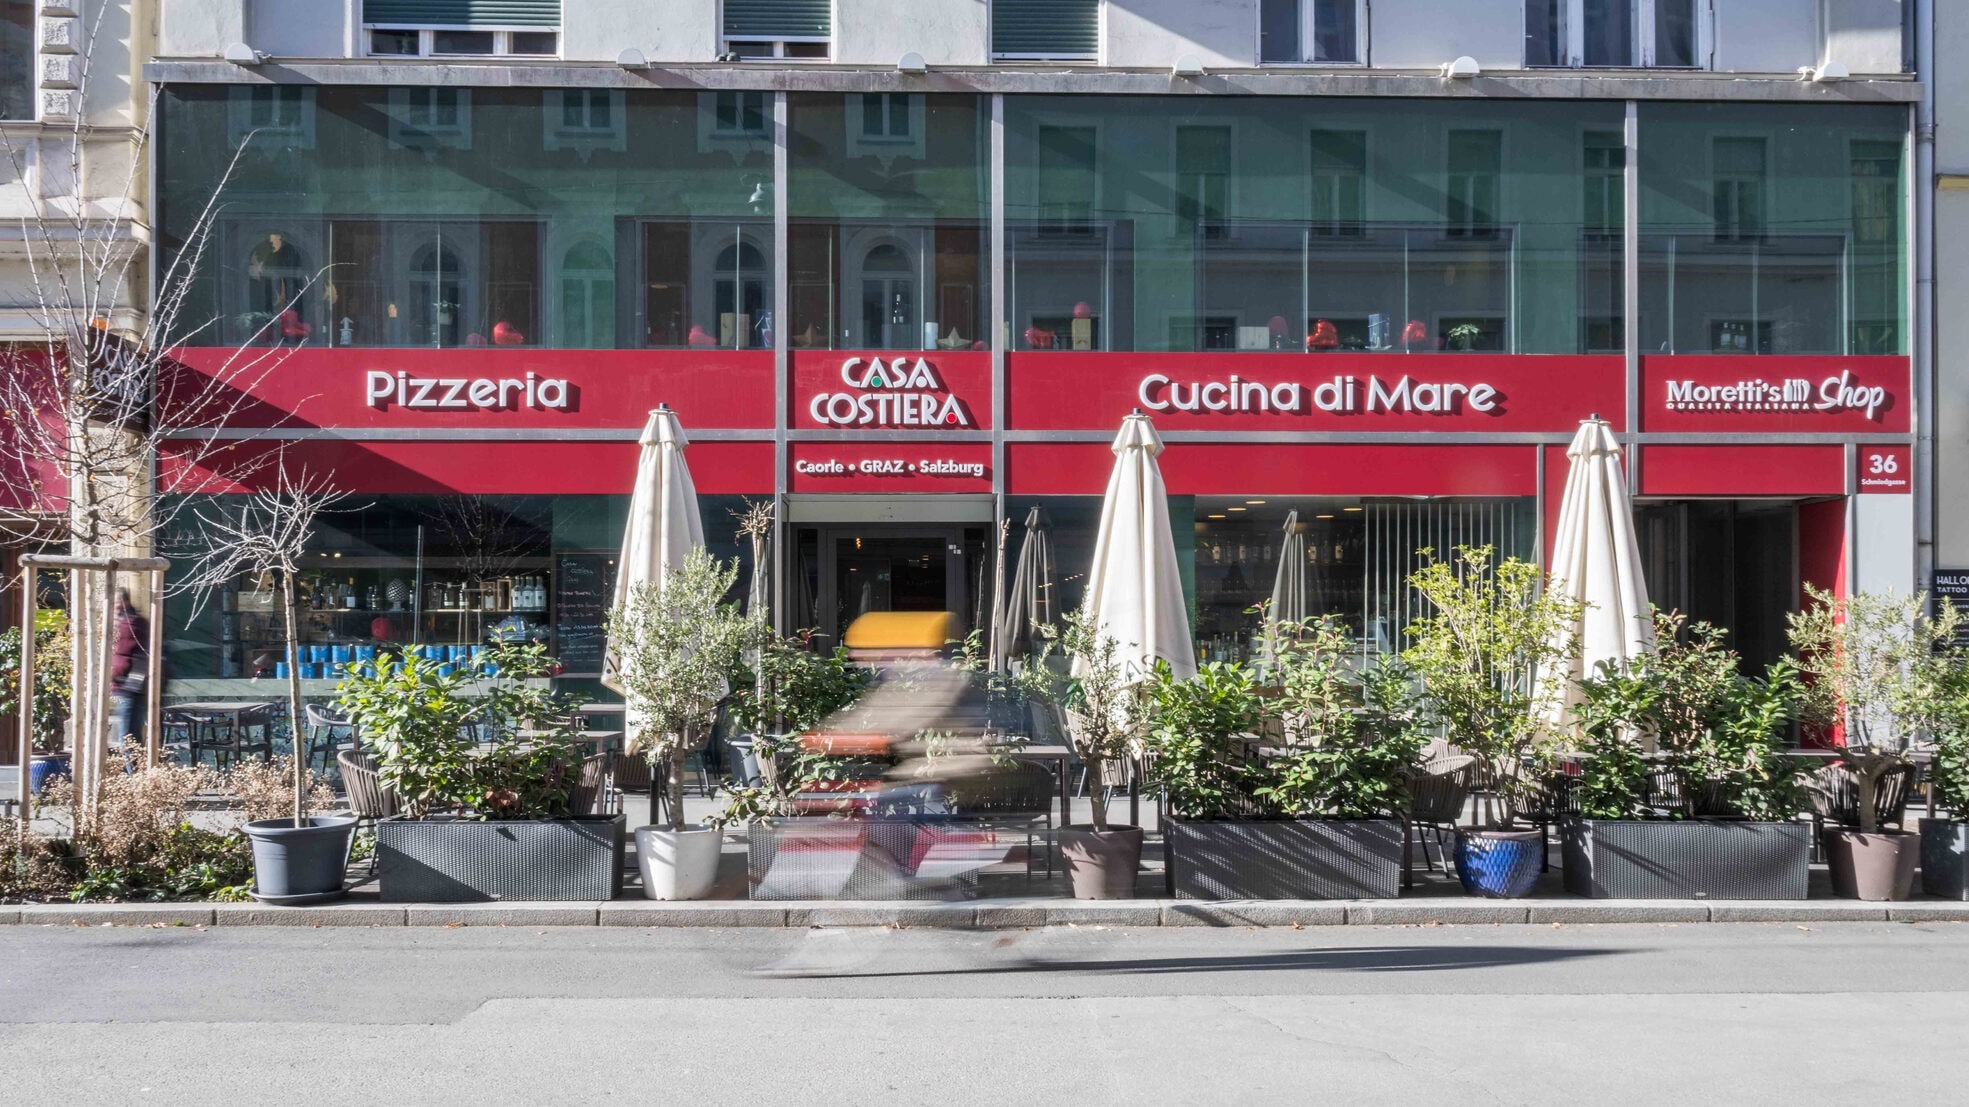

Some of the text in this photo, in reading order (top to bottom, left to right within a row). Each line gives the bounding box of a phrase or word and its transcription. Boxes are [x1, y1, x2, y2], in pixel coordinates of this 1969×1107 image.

[841, 357, 938, 388] CASA
[366, 371, 567, 407] Pizzeria
[1138, 373, 1497, 412] Cucina di Mare
[1665, 369, 1885, 420] Moretti's Shop
[810, 393, 968, 425] COSTIERA
[1737, 402, 1810, 410] ITALIANA
[796, 459, 984, 476] Caorle GRAZ Salzburg
[1869, 454, 1898, 474] 36
[1937, 576, 1969, 585] HALL O
